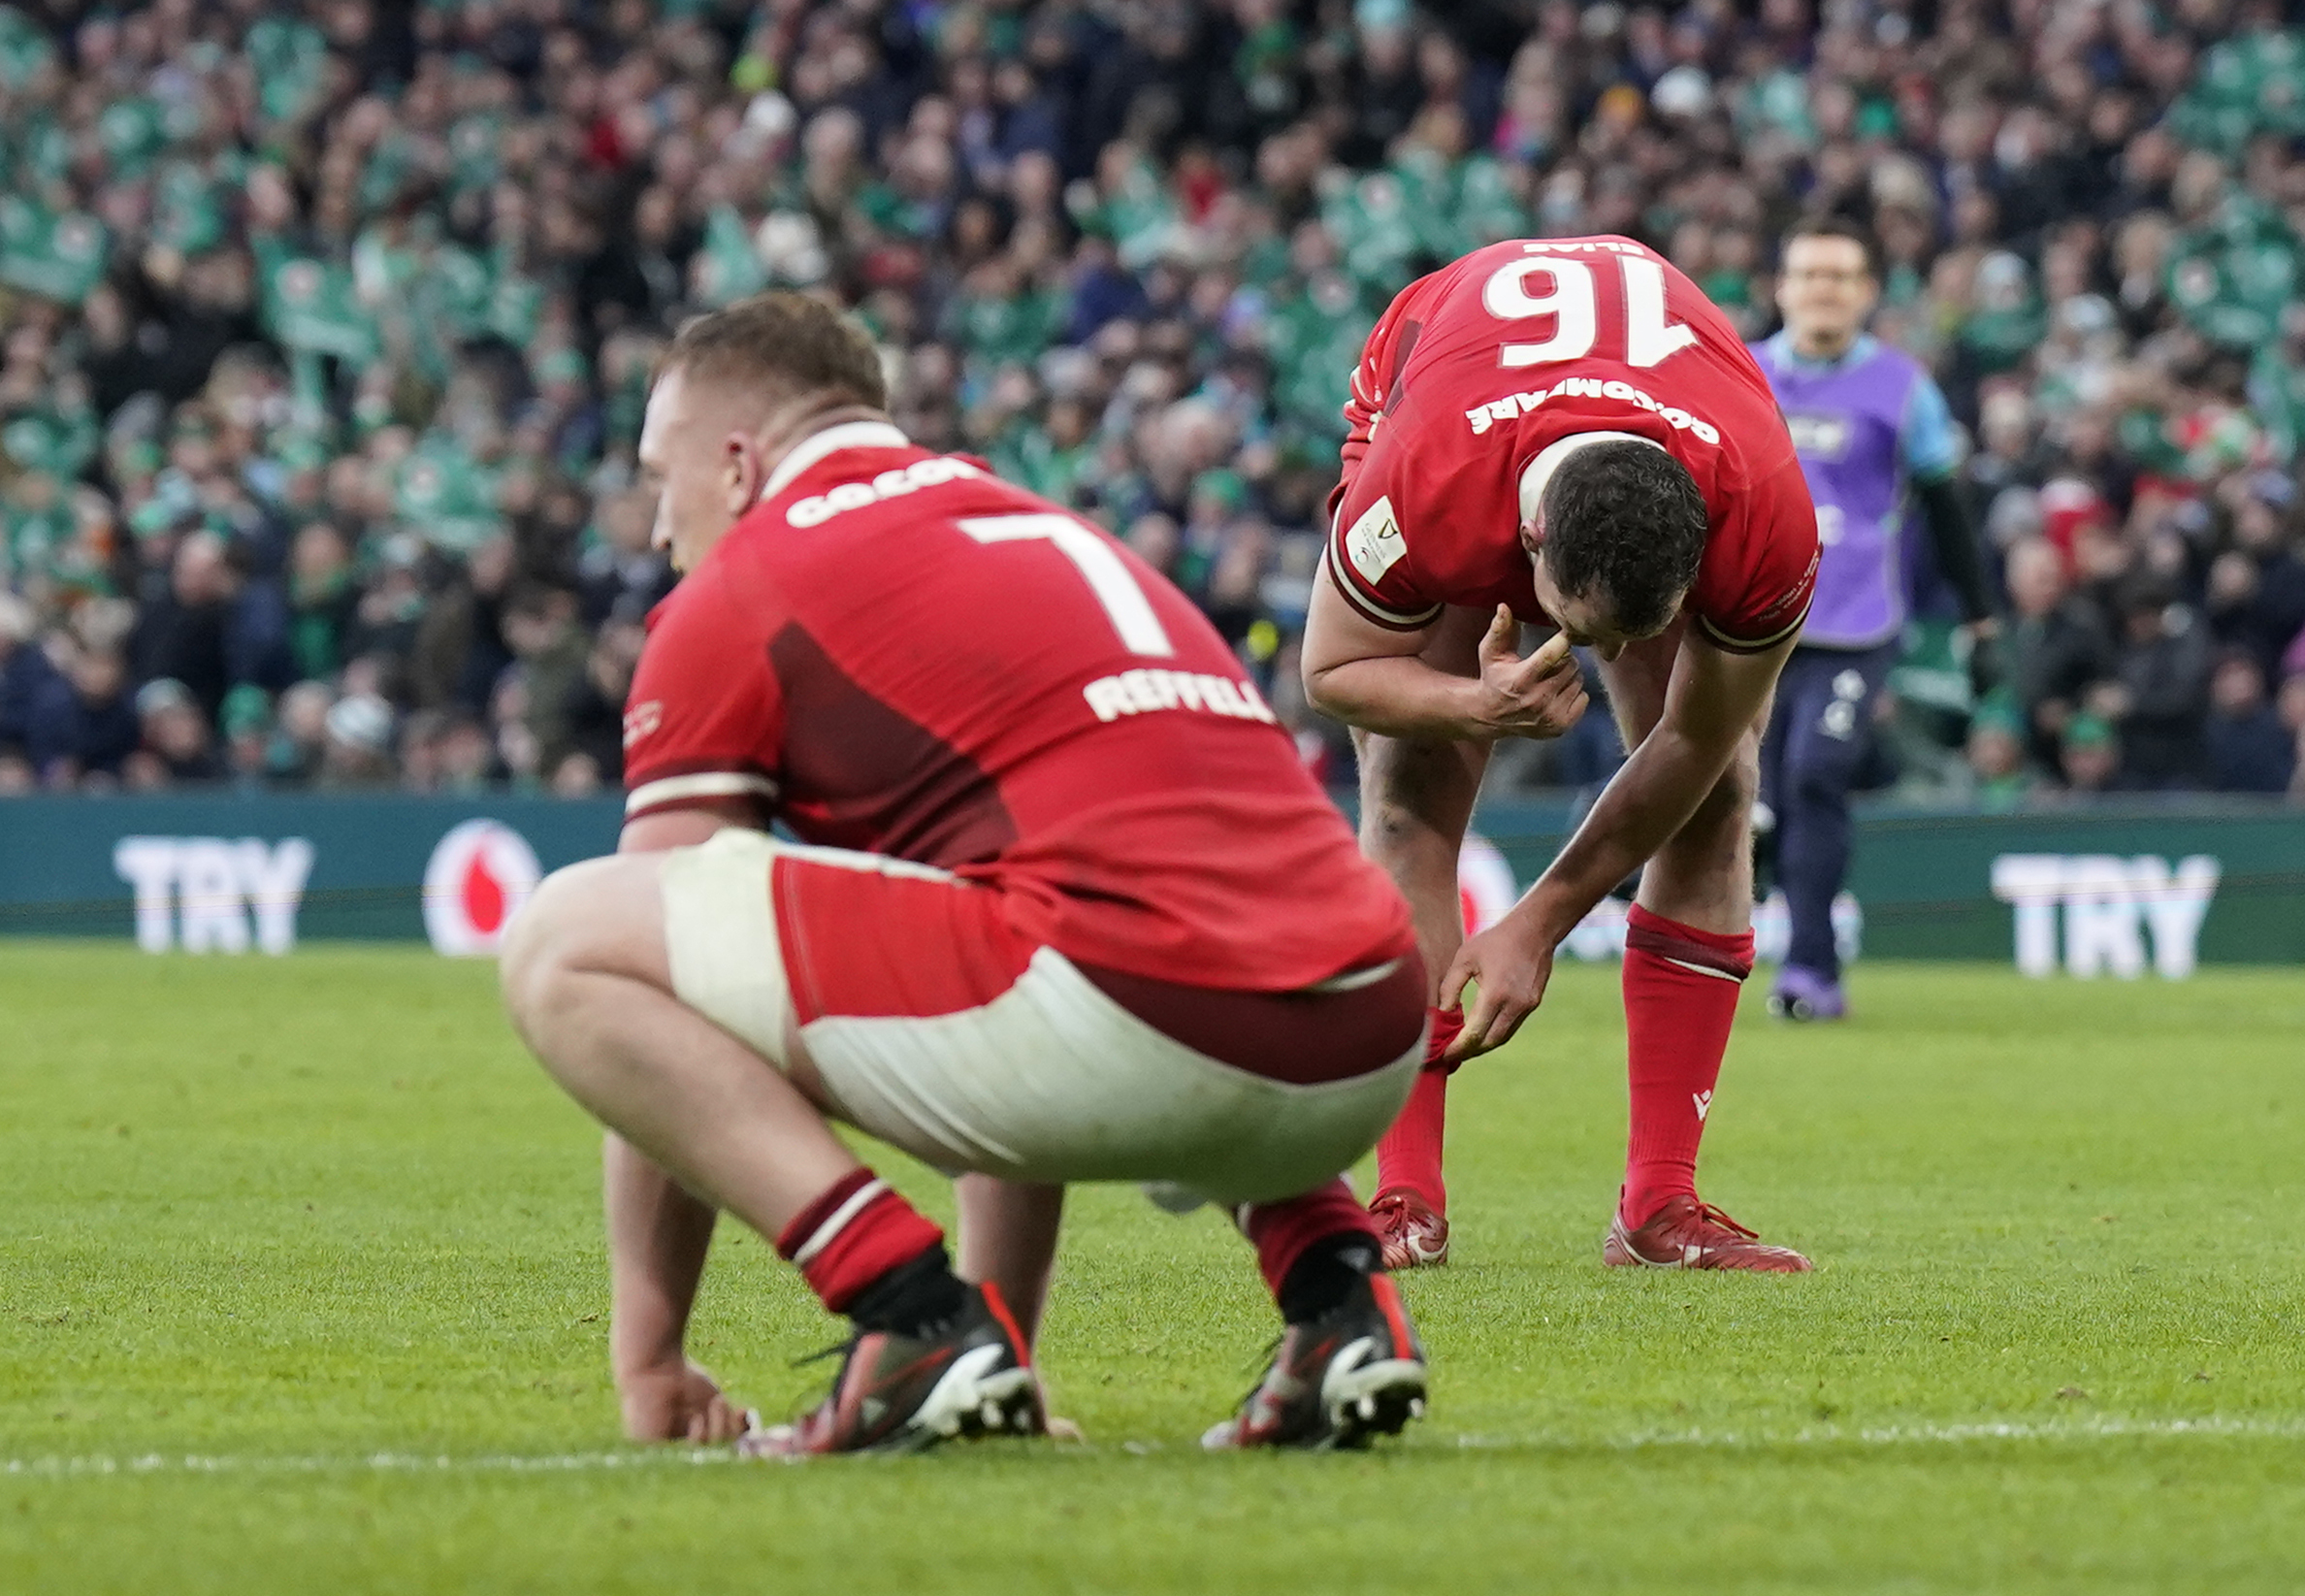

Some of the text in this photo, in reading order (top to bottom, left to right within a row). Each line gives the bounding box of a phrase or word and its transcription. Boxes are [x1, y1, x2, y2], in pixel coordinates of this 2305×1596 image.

[1522, 242, 1645, 256] ELIAS
[1482, 255, 1701, 369] 16
[956, 513, 1174, 658] 7
[114, 836, 313, 956] TRY
[1992, 854, 2220, 980] TRY
